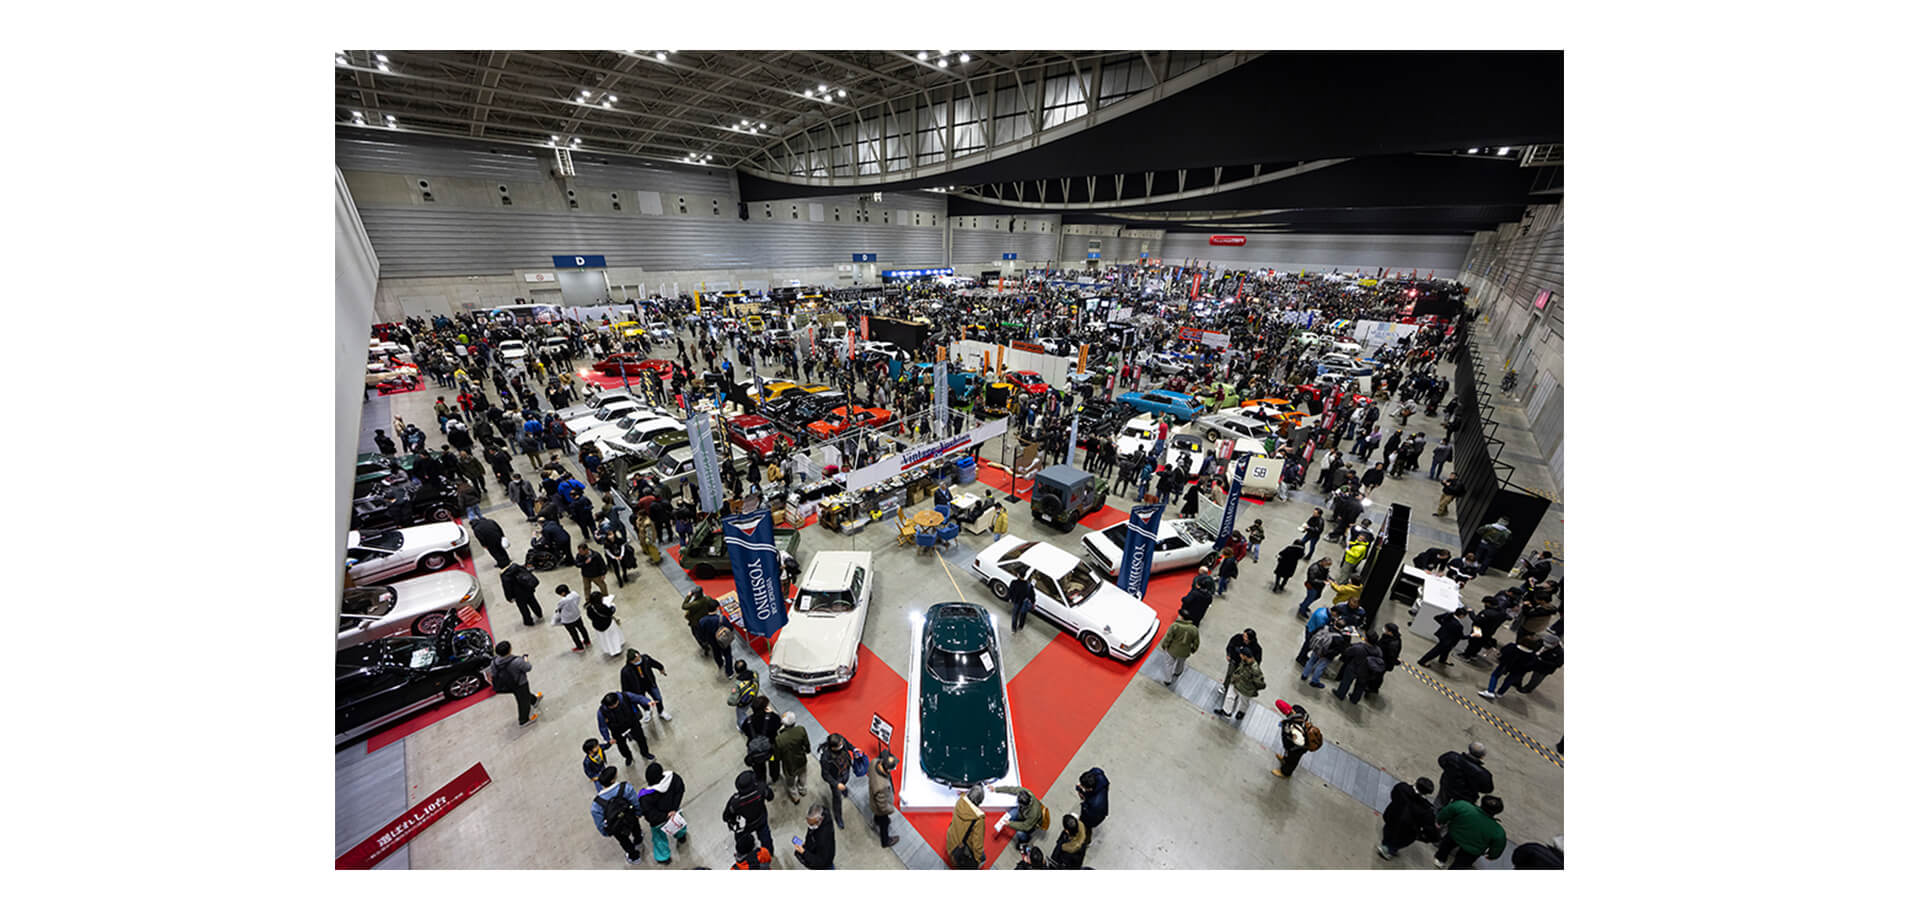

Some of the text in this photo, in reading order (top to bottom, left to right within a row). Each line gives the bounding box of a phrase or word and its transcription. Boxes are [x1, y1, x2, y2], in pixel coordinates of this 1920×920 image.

[575, 256, 585, 266] D
[1253, 466, 1266, 478] 58
[747, 558, 771, 620] YOSHINO
